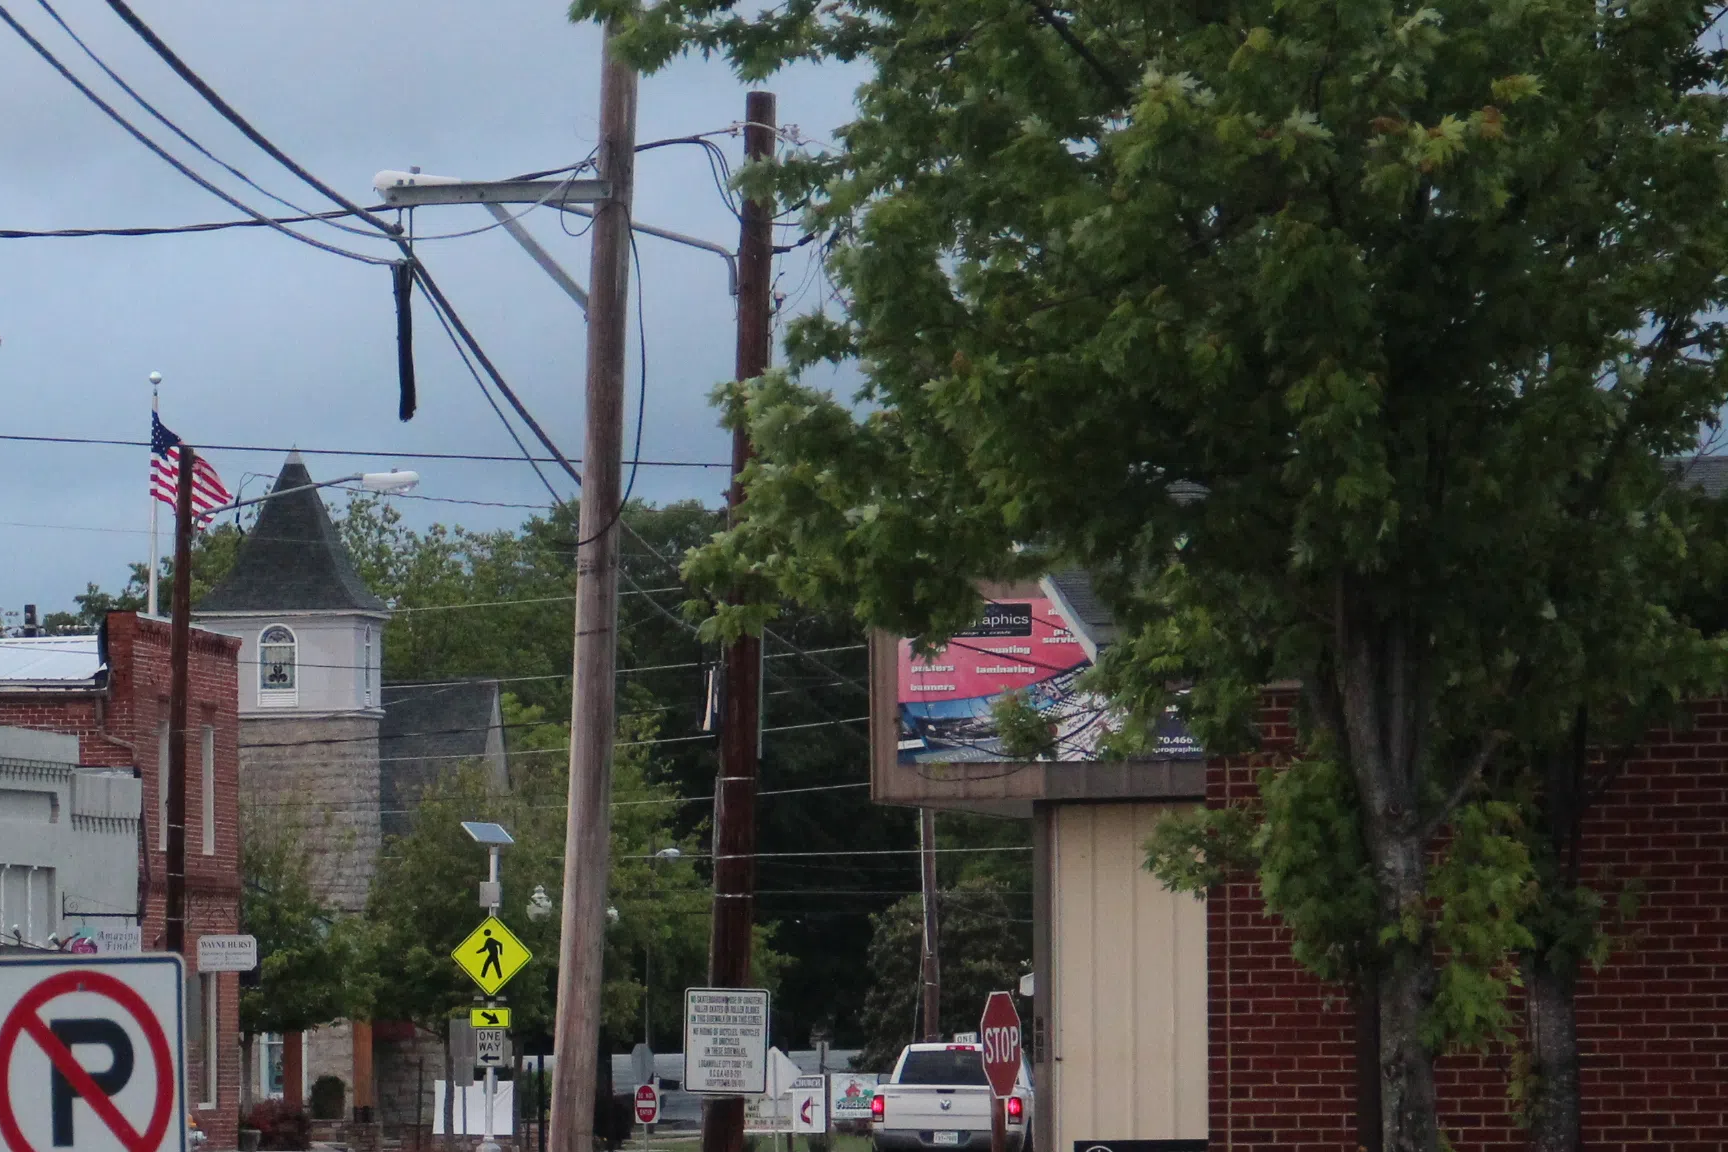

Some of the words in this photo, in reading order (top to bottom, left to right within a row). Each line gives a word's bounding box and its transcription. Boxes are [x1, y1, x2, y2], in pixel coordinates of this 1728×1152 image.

[1042, 635, 1078, 644] servic
[975, 664, 1036, 675] laminating
[910, 683, 956, 692] banners
[97, 931, 139, 944] Amazing
[200, 941, 226, 949] WAYNE
[227, 941, 252, 949] HURST
[479, 1031, 501, 1042] ONE
[956, 1034, 974, 1043] ONE
[479, 1042, 501, 1052] WAY
[985, 1025, 1019, 1064] STOP
[49, 1017, 135, 1147] P
[637, 1092, 644, 1100] DO
[645, 1092, 654, 1100] NOT
